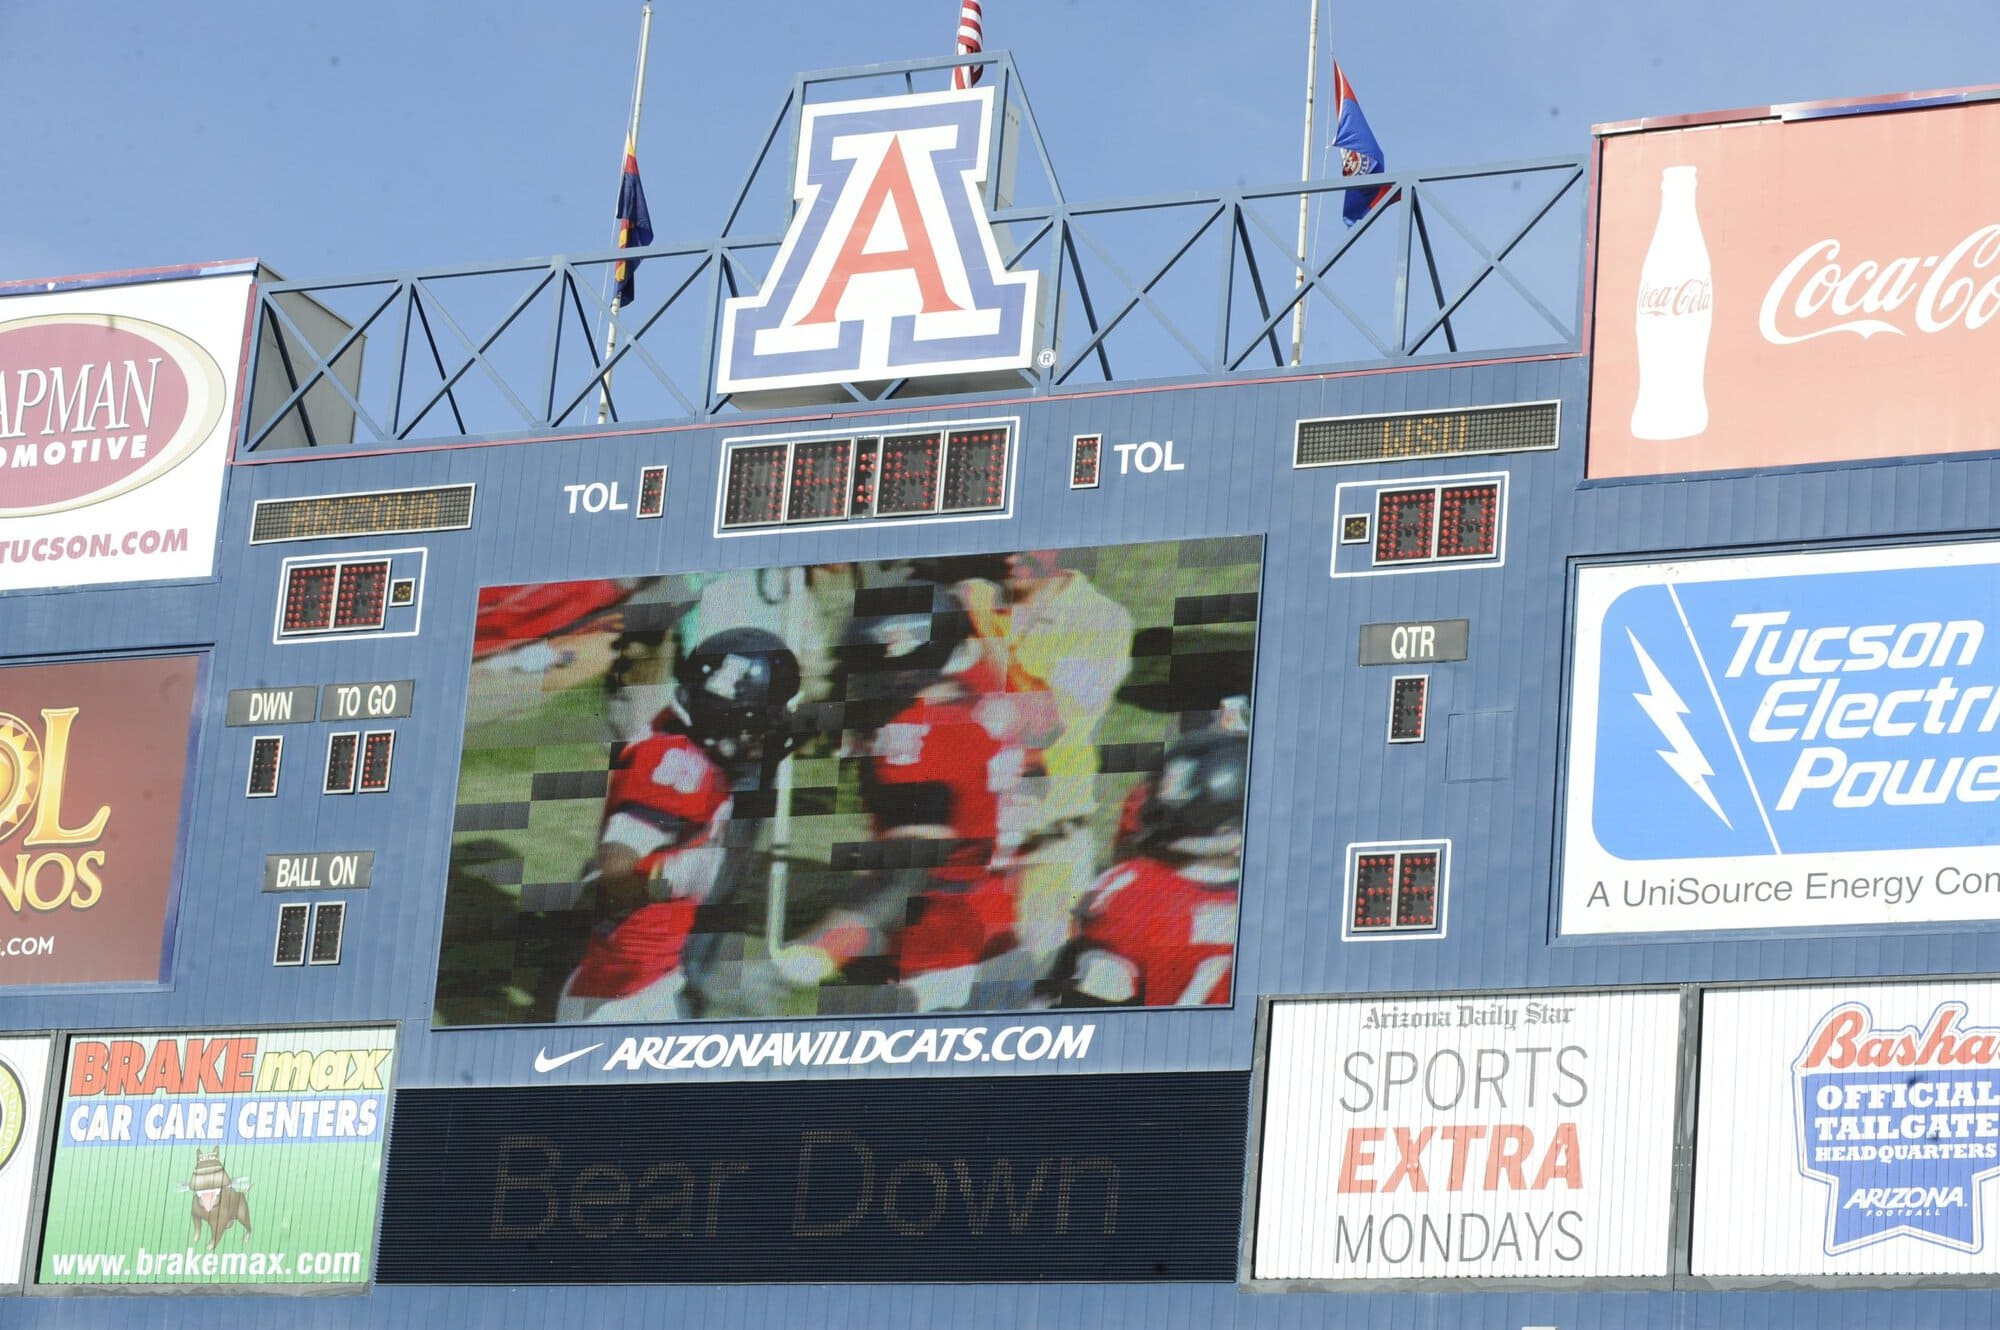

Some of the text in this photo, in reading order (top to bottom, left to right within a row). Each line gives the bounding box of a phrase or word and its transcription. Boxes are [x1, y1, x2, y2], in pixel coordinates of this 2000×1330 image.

[1381, 415, 1467, 457] WSU
[1113, 440, 1184, 475] TOL
[563, 481, 628, 514] TOL
[290, 492, 439, 539] ARIZONA
[1391, 625, 1436, 660] QTR
[1724, 611, 1985, 678] Tucson
[249, 691, 293, 722] DWN
[337, 684, 397, 717] TO GO
[1775, 746, 2000, 811] Powe
[276, 855, 358, 888] BALL ON
[1587, 881, 1610, 907] A
[1624, 877, 1793, 907] UniSource
[1806, 872, 1923, 904] Energy
[1362, 1002, 1576, 1031] Arizona Daily Star
[602, 1024, 1096, 1071] ARIZONAWILDCATS.COM
[1799, 1009, 2000, 1069] Basha
[1339, 1045, 1588, 1113] SPORTS
[1816, 1081, 2000, 1111] OFFICIAL
[69, 1098, 379, 1142] CAR CARE CENTERS
[1815, 1113, 1999, 1141] TAILGATE
[1337, 1122, 1583, 1194] EXTRA
[1815, 1143, 1997, 1164] HEADQUARTERS
[490, 1130, 1121, 1240] Bear Down
[1866, 1208, 1941, 1217] FOOTBALL
[1335, 1210, 1583, 1264] MONDAYS
[52, 1248, 361, 1276] www.brakemax.com
